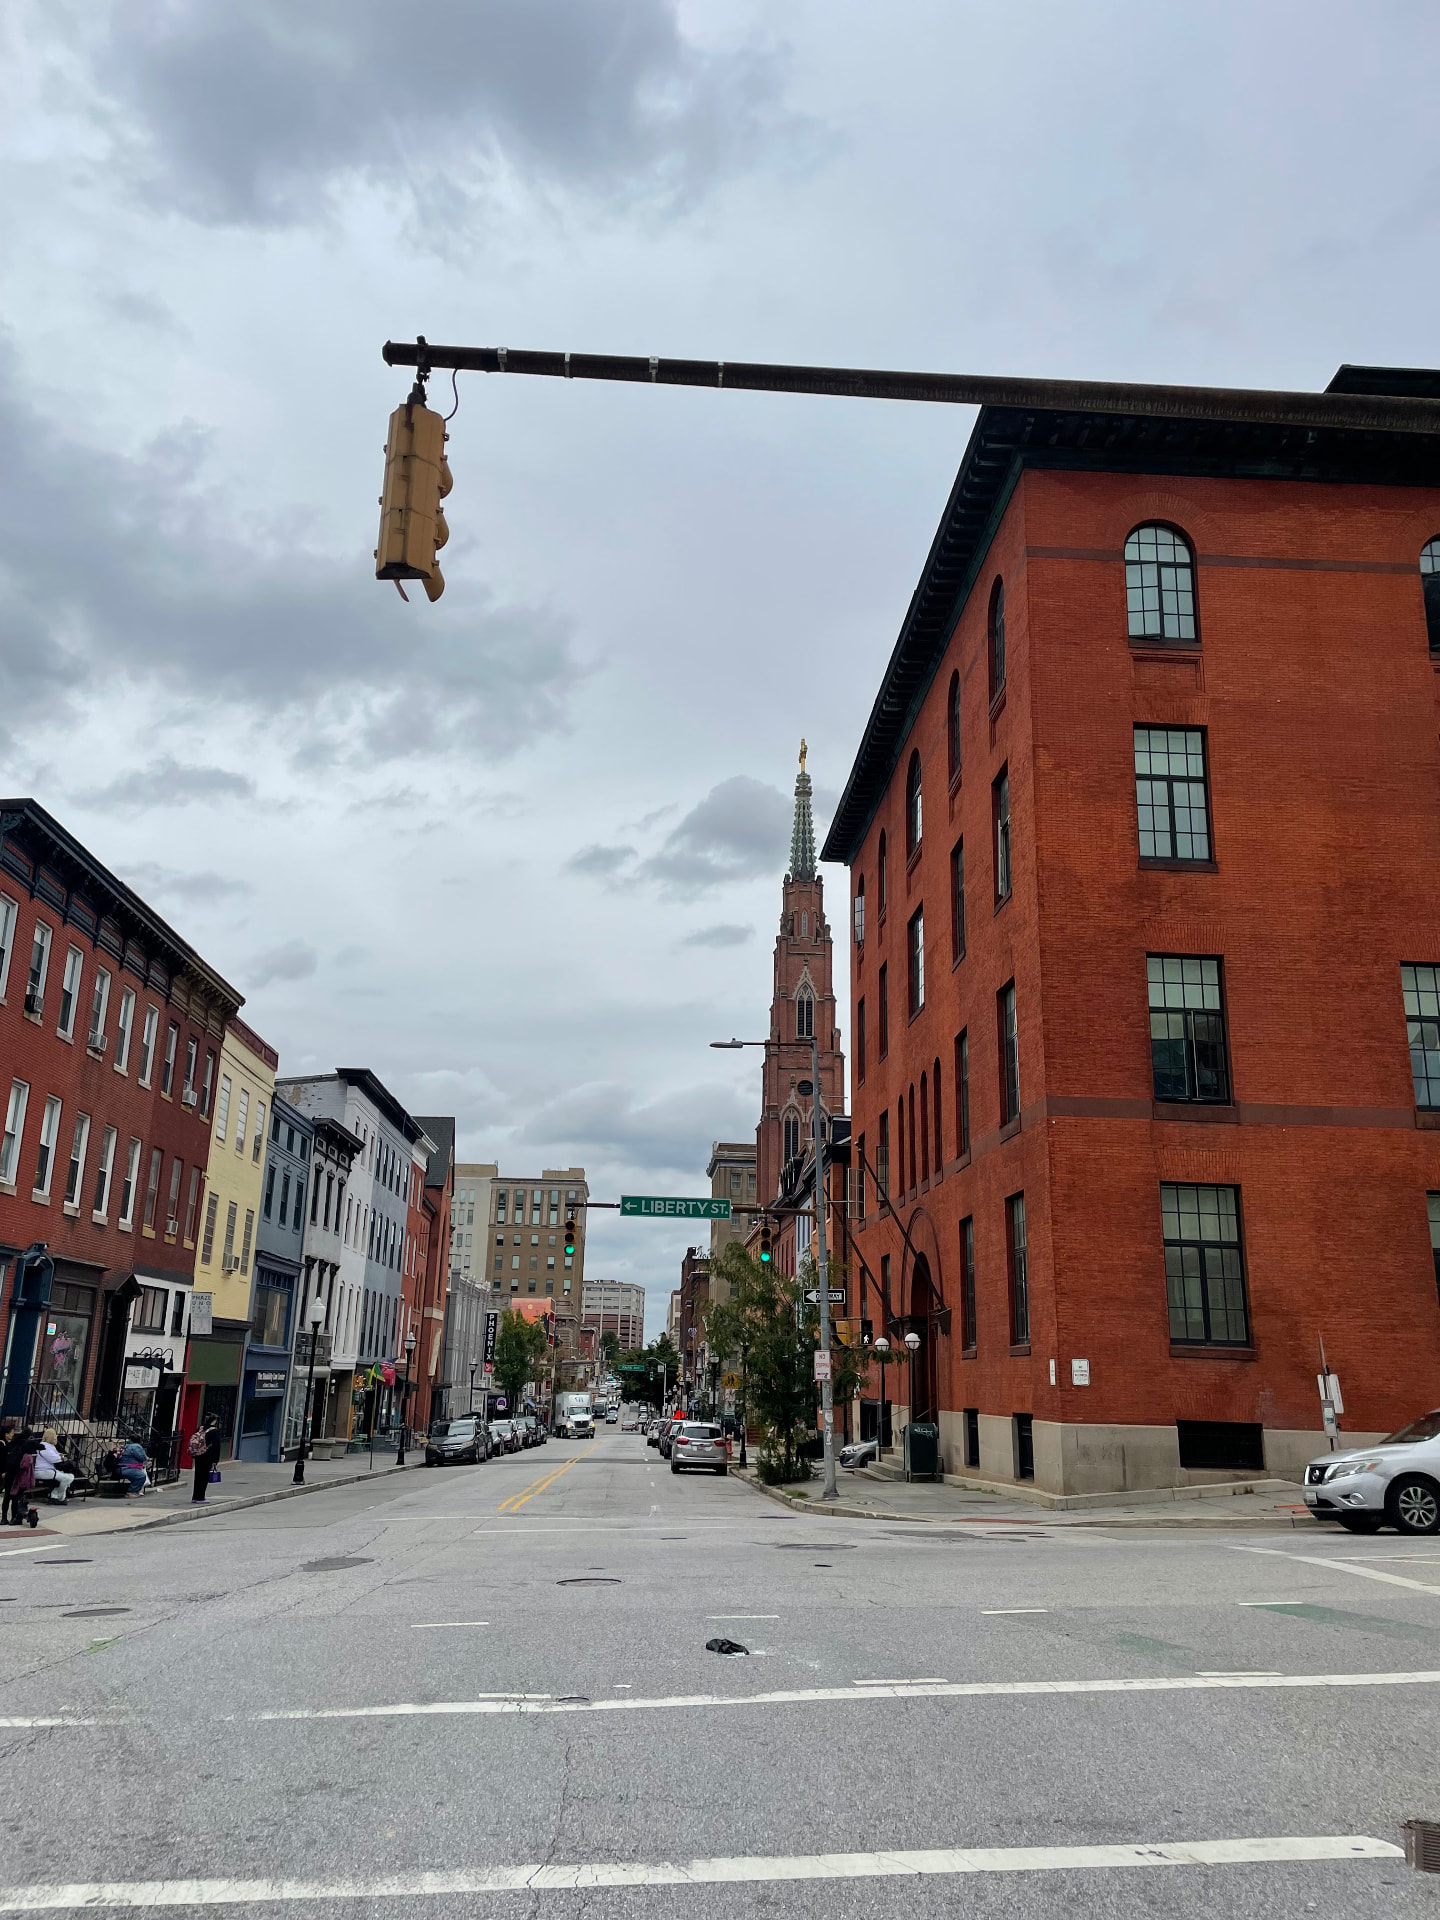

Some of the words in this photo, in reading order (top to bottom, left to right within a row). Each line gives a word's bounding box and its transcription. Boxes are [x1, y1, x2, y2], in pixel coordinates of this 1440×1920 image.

[641, 1199, 708, 1215] LIBERTY
[710, 1203, 729, 1215] ST.
[486, 1314, 495, 1360] PHOENIX
